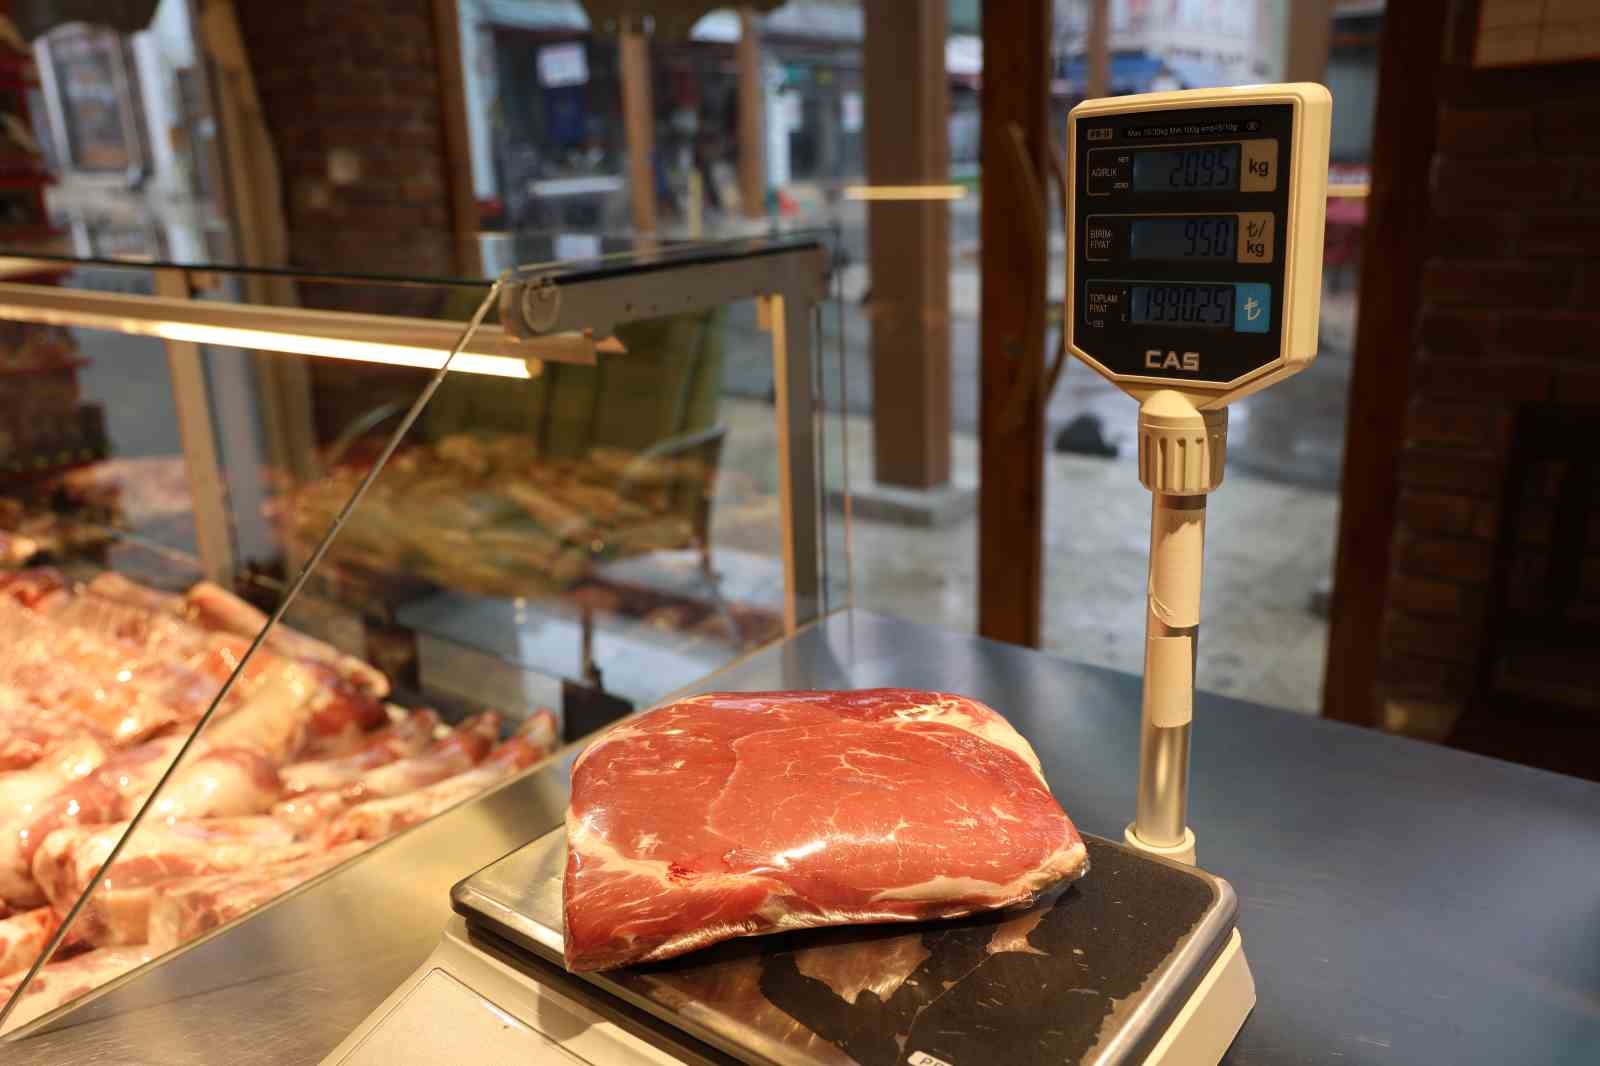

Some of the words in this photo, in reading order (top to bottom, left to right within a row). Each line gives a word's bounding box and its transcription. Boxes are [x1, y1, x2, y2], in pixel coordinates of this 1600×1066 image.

[1248, 157, 1269, 178] kg
[1184, 220, 1230, 257] 950
[1247, 240, 1264, 257] kg
[1145, 349, 1200, 371] CAS
